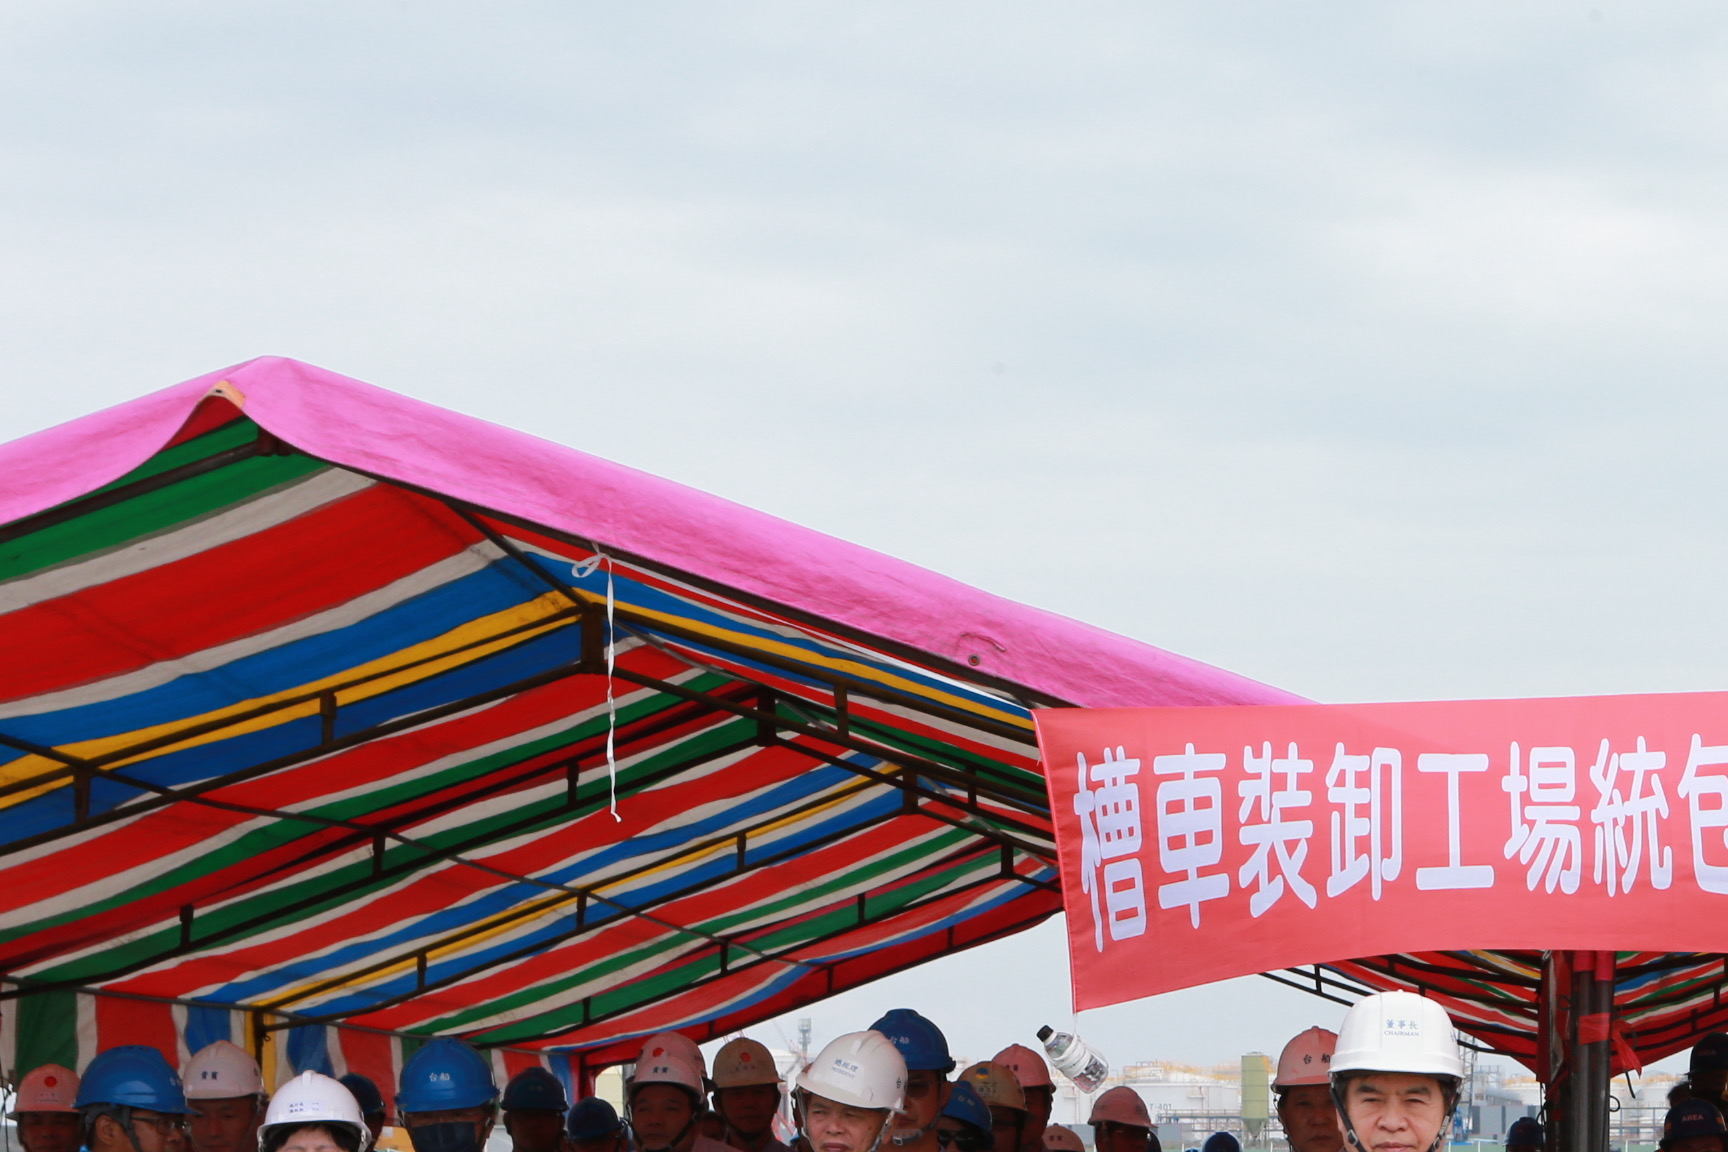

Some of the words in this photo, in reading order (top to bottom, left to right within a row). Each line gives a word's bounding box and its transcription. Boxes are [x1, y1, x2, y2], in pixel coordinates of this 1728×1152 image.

[1385, 1018, 1419, 1030] 董事長
[1384, 1030, 1420, 1038] CHAIRMAN
[1304, 1053, 1331, 1065] 台船
[429, 1072, 450, 1082] 台船
[1150, 1102, 1173, 1111] T-401
[1682, 1114, 1705, 1122] AREA
